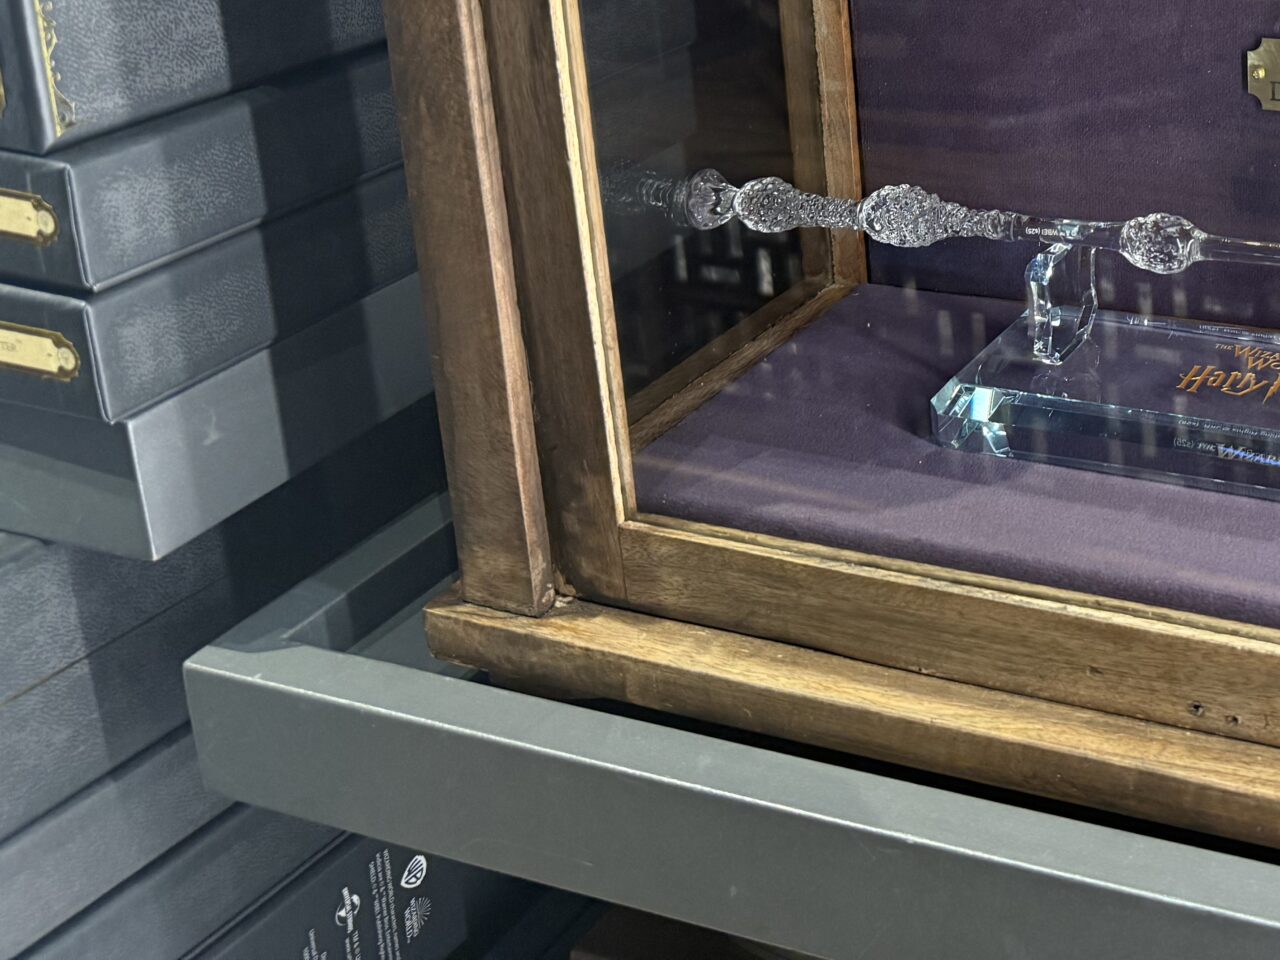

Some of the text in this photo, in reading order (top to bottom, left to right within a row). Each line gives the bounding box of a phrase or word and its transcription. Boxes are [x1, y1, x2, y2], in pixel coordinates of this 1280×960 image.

[1041, 228, 1058, 236] WBEI
[1215, 343, 1234, 351] THE
[1175, 365, 1270, 397] Harry
